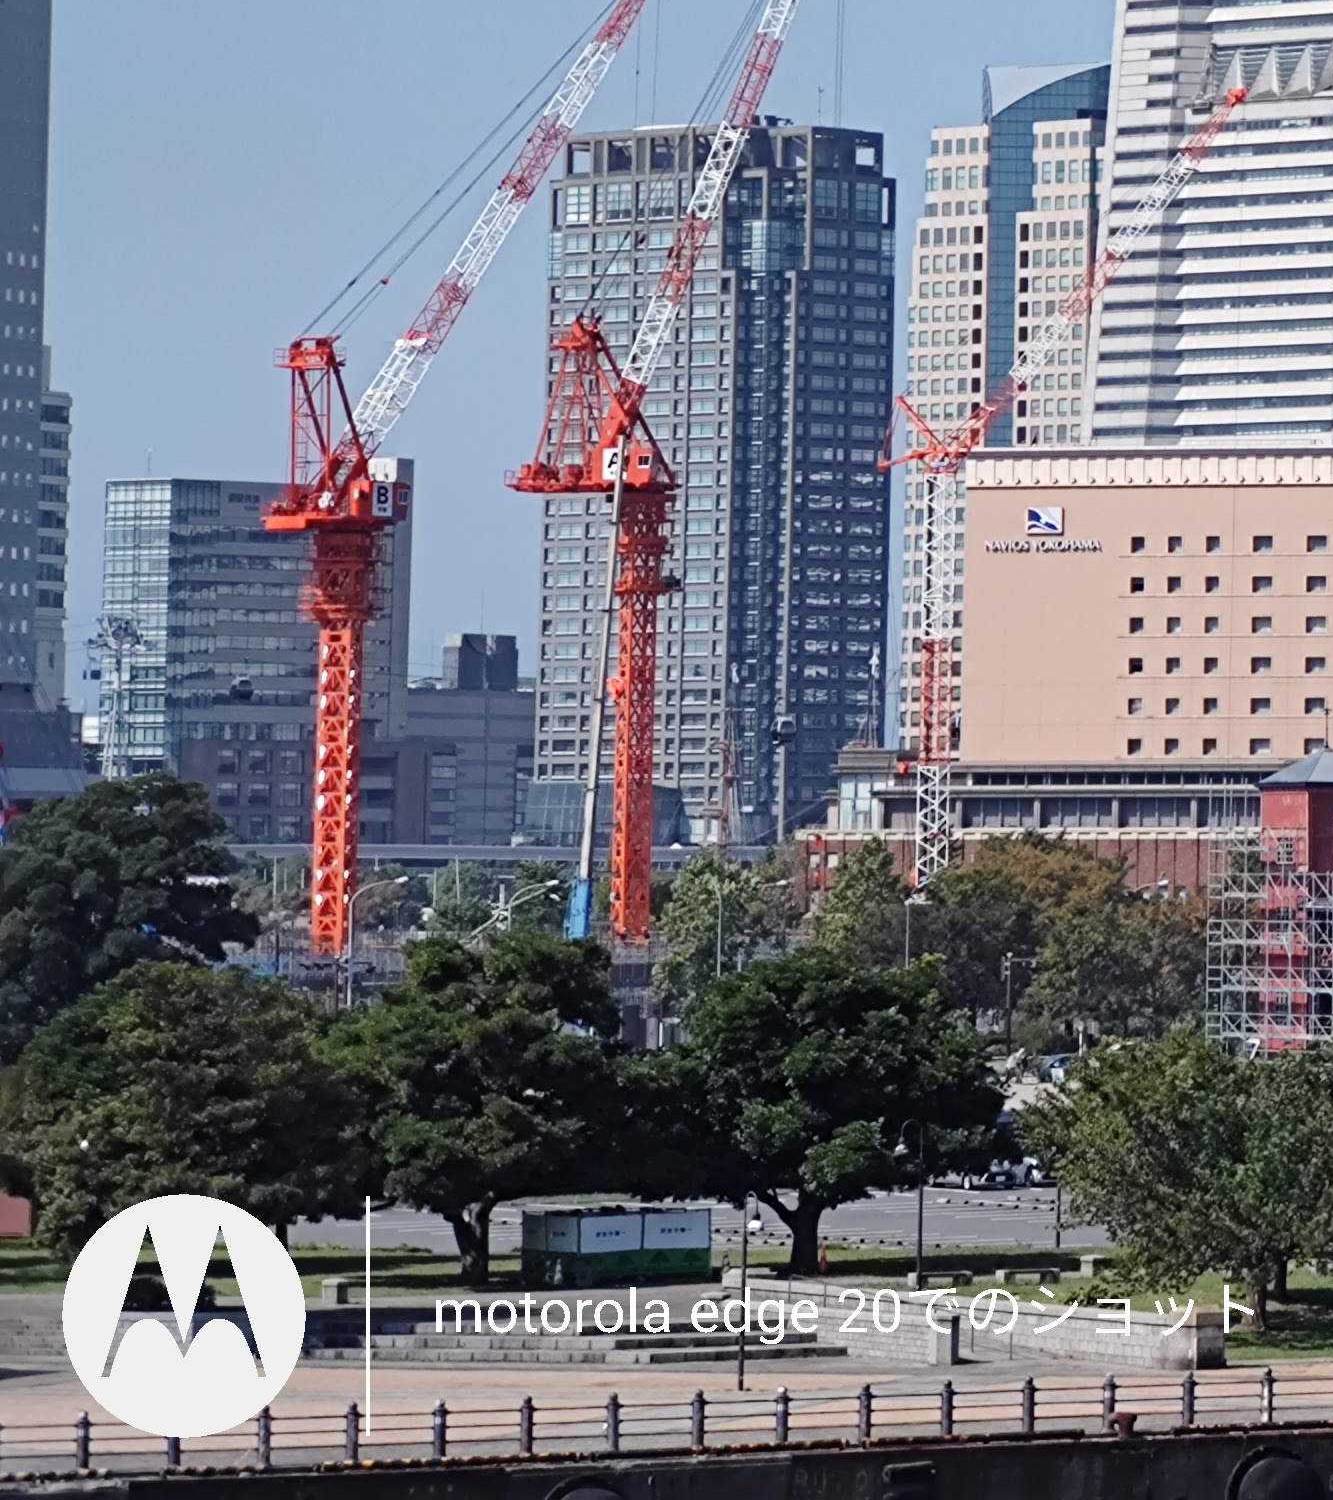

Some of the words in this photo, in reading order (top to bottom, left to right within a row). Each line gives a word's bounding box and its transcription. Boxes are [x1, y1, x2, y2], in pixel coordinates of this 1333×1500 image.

[377, 485, 389, 505] B
[984, 539, 1029, 552] NAVIOS
[1031, 539, 1102, 552] YOKOHAMA
